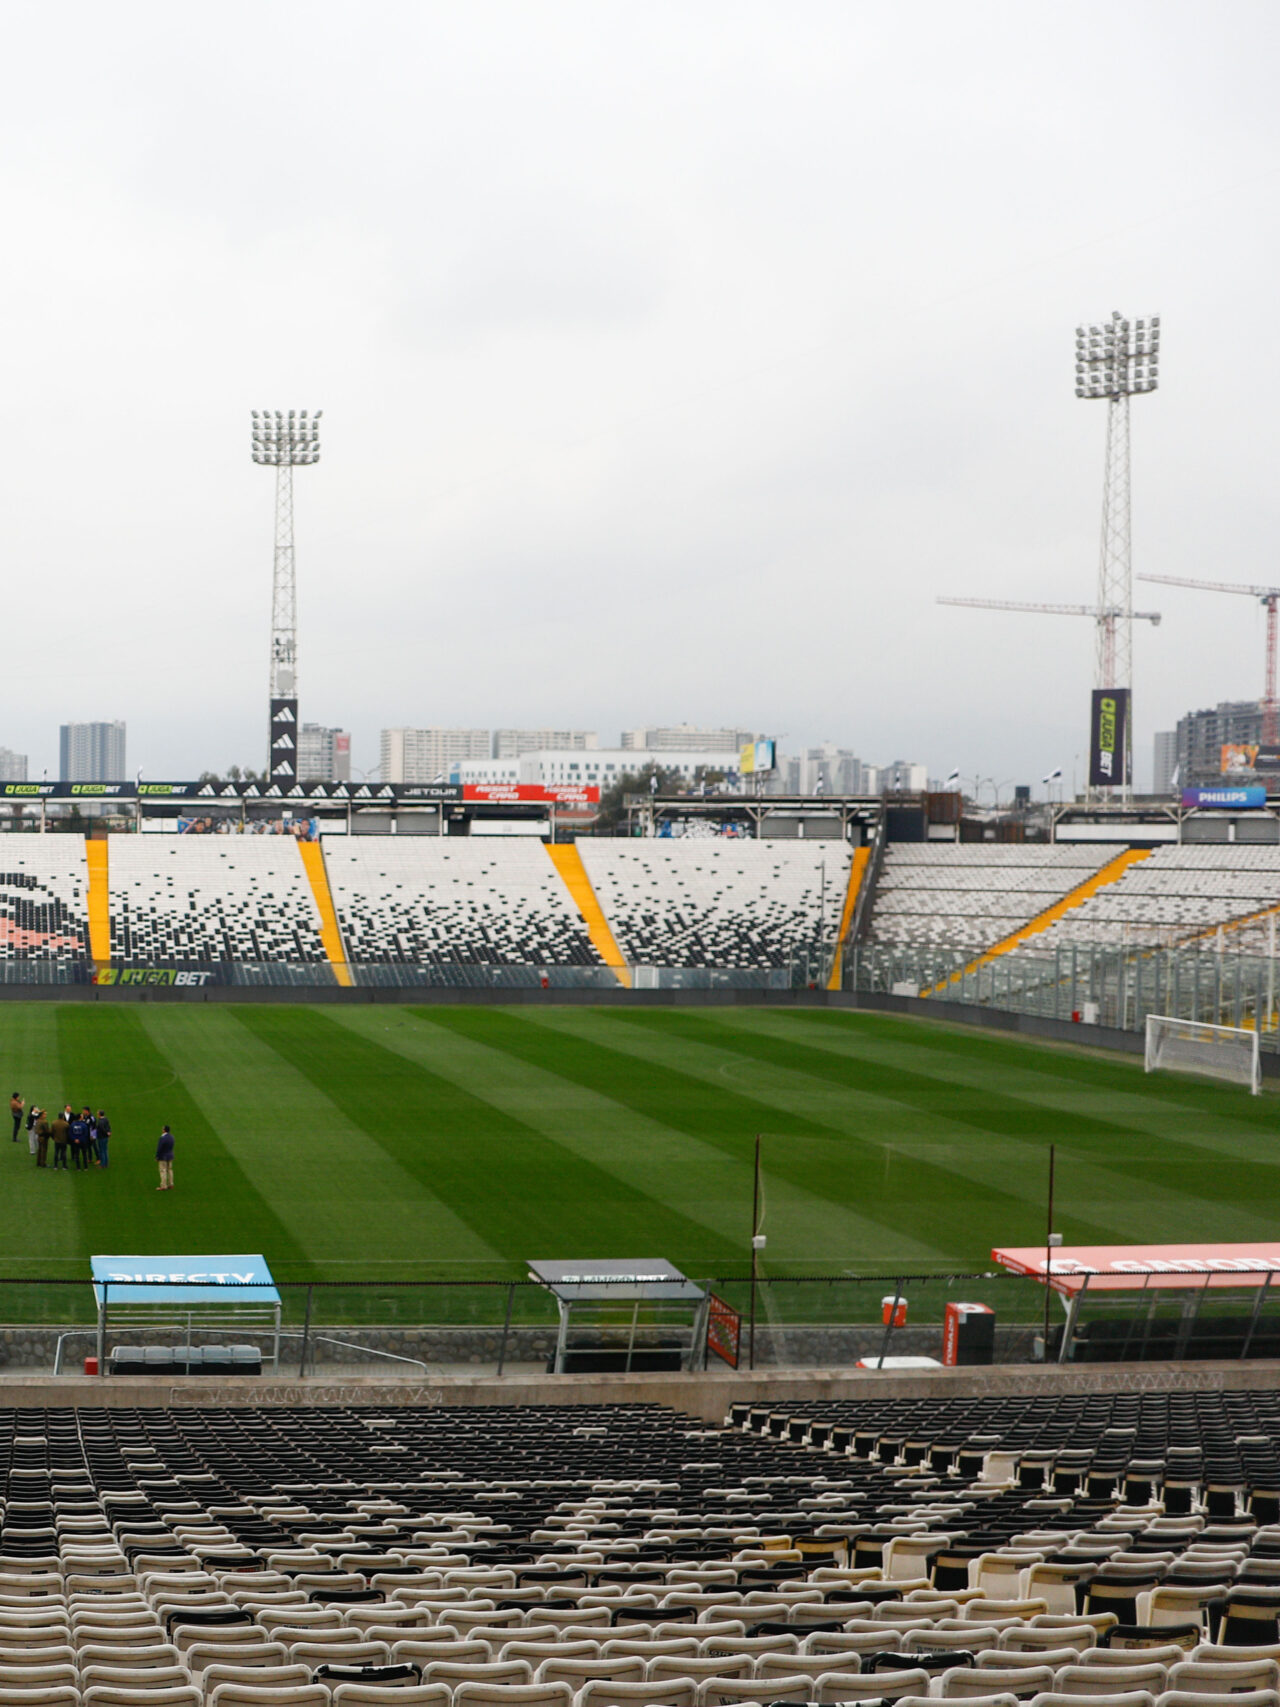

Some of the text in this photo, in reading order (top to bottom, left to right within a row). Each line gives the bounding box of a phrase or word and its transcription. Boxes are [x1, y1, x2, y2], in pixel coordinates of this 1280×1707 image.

[404, 788, 457, 796] JETOUR
[1198, 792, 1247, 802] PHILIPS
[1110, 1257, 1280, 1272] GATOR
